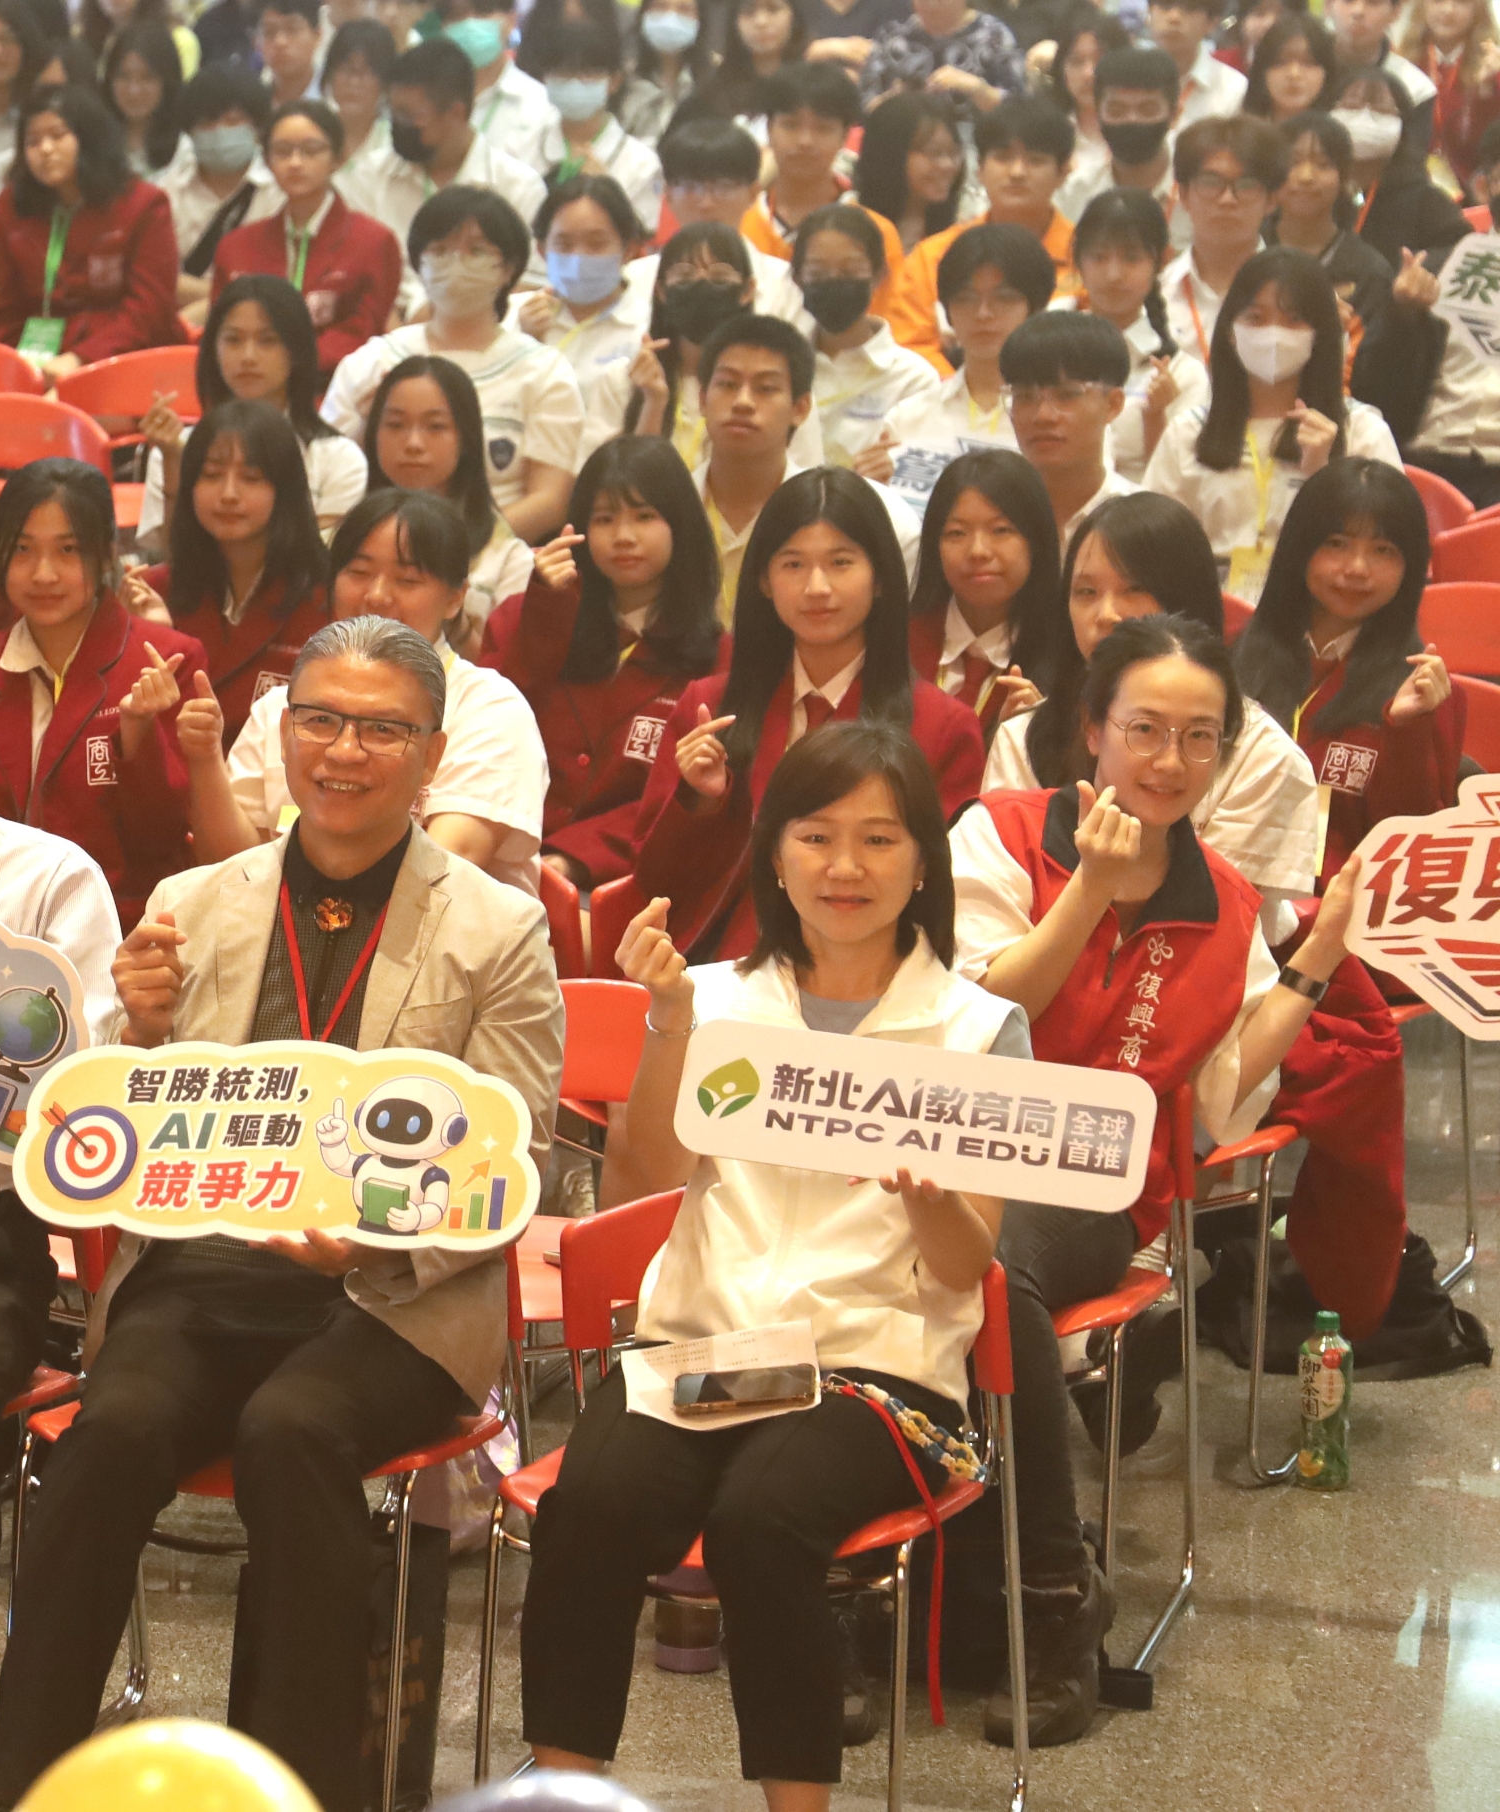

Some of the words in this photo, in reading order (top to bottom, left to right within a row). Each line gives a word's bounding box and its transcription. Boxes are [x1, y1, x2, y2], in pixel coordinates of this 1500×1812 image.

[127, 1066, 309, 1103] 智勝統測,
[770, 1063, 1058, 1139] 新北AI教育局
[148, 1113, 217, 1149] AI
[222, 1113, 302, 1148] 驅動
[765, 1109, 886, 1143] NTPC
[895, 1129, 942, 1152] AI
[956, 1136, 1051, 1167] EDU
[1071, 1110, 1126, 1141] 全球
[1066, 1139, 1123, 1170] 首推
[136, 1160, 300, 1209] 競爭力
